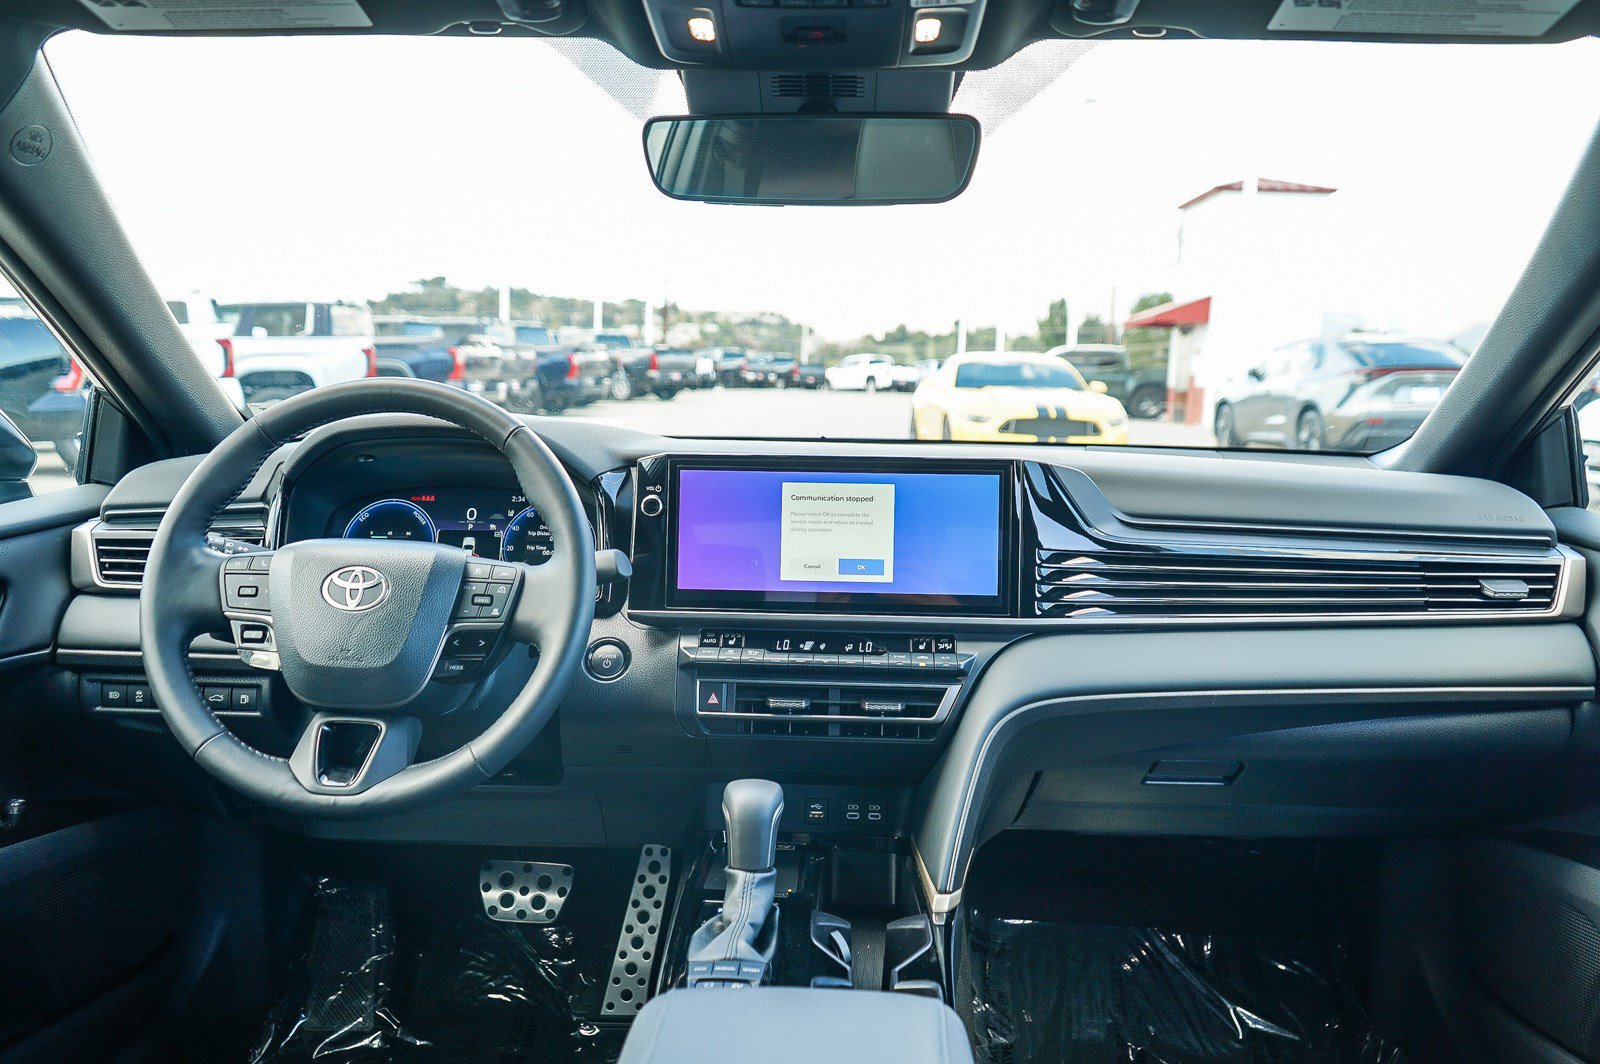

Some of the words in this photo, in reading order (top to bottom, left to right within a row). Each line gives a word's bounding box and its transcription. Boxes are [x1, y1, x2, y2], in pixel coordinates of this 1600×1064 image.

[790, 494, 845, 502] Communication
[845, 495, 874, 503] stopped
[466, 507, 477, 521] 0
[1497, 514, 1525, 523] AIRBAG
[468, 523, 474, 531] P
